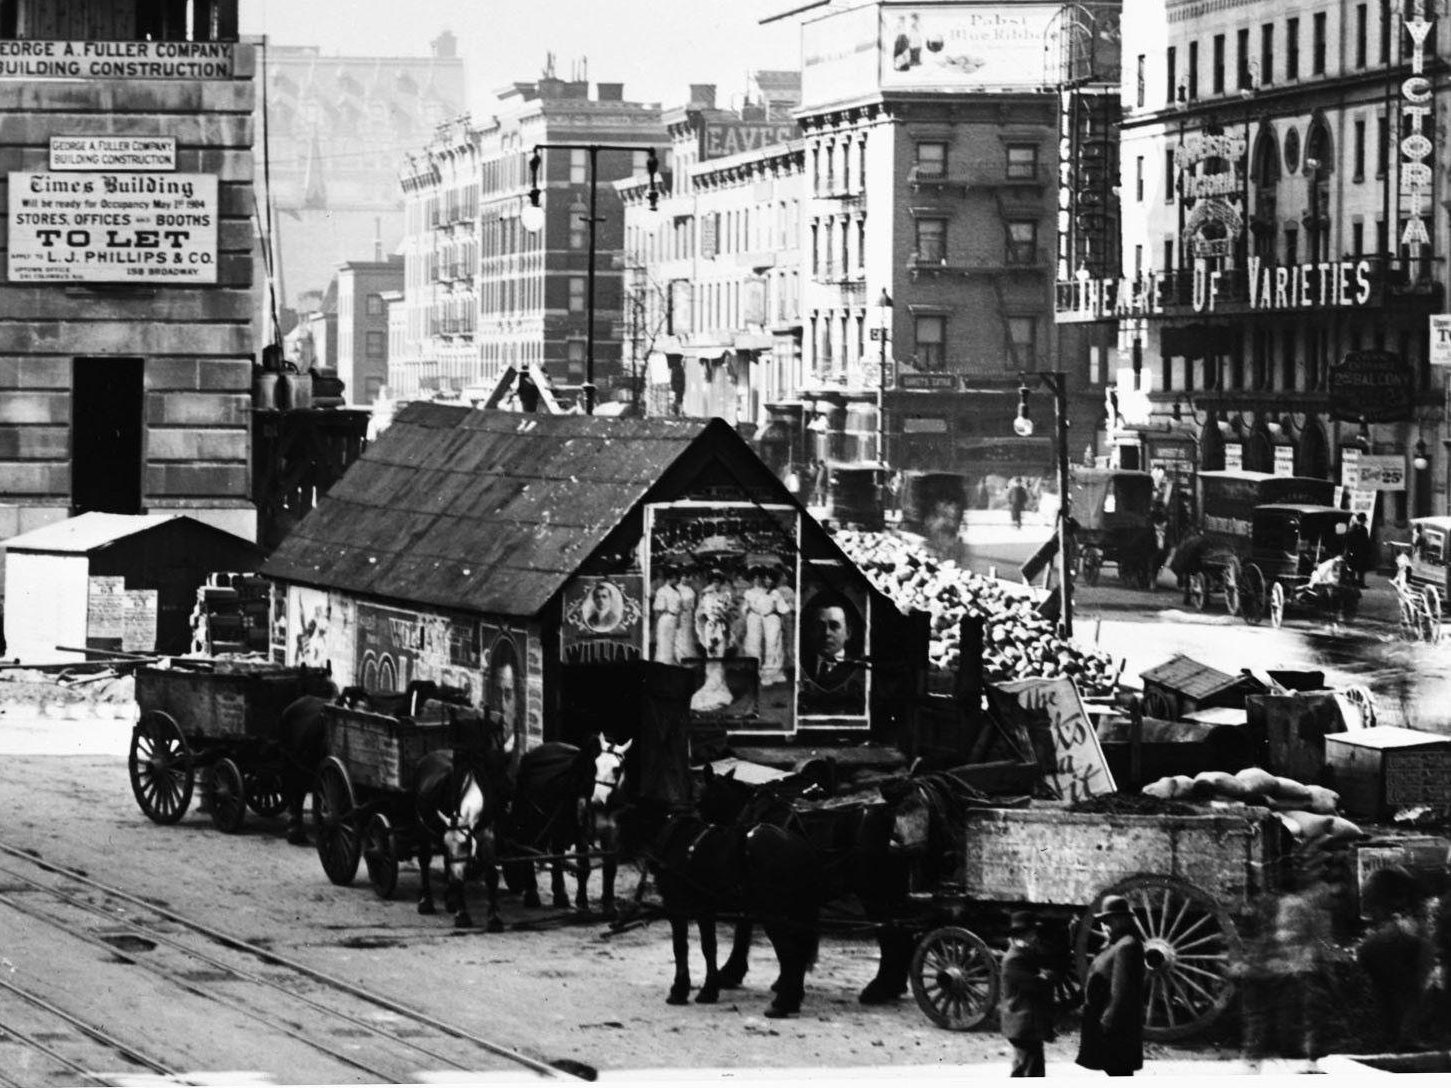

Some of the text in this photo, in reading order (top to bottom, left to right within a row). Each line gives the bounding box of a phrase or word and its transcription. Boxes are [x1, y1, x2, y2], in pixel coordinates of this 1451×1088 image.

[84, 42, 149, 59] FULLER
[1400, 21, 1433, 245] VICTORIA
[52, 141, 87, 151] GEORGE
[99, 141, 130, 151] FULLER
[54, 154, 100, 164] BUILDING
[30, 175, 194, 198] Times Building
[21, 199, 38, 208] Will
[41, 199, 53, 209] be
[55, 200, 83, 211] ready
[84, 199, 97, 209] for
[100, 200, 150, 211] Occupancy
[153, 199, 172, 211] May
[74, 213, 131, 226] OFFICES
[155, 214, 211, 227] BOOTHS
[36, 230, 190, 248] TO LET
[47, 251, 62, 263] L.
[64, 251, 80, 263] J.
[85, 251, 167, 263] PHILLIPS
[173, 252, 184, 263] &
[148, 268, 199, 276] BROADWAY
[1191, 259, 1222, 312] OF
[1247, 255, 1372, 309] VARIETIES
